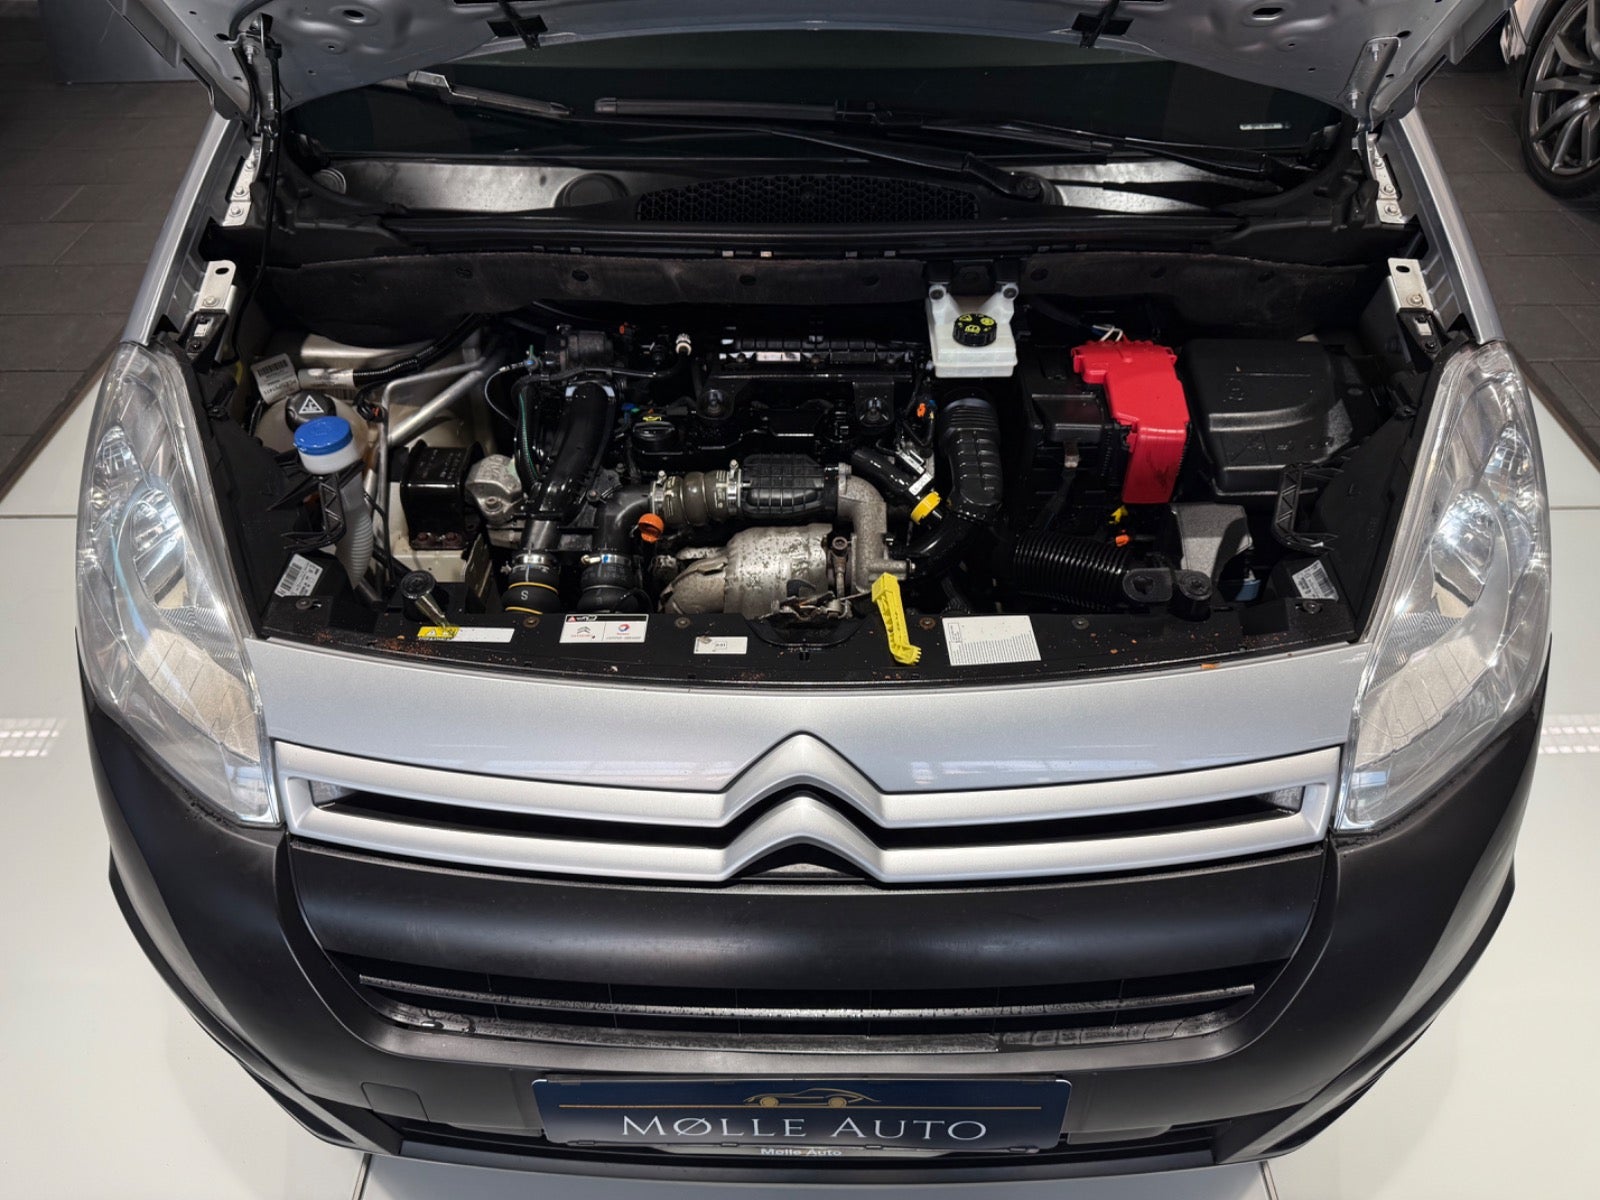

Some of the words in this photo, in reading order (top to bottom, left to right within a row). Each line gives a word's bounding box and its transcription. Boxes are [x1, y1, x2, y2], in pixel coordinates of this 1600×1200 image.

[520, 590, 529, 601] S
[621, 1115, 808, 1137] MØLLE
[829, 1116, 987, 1141] AUTO
[806, 1149, 842, 1157] Auto
